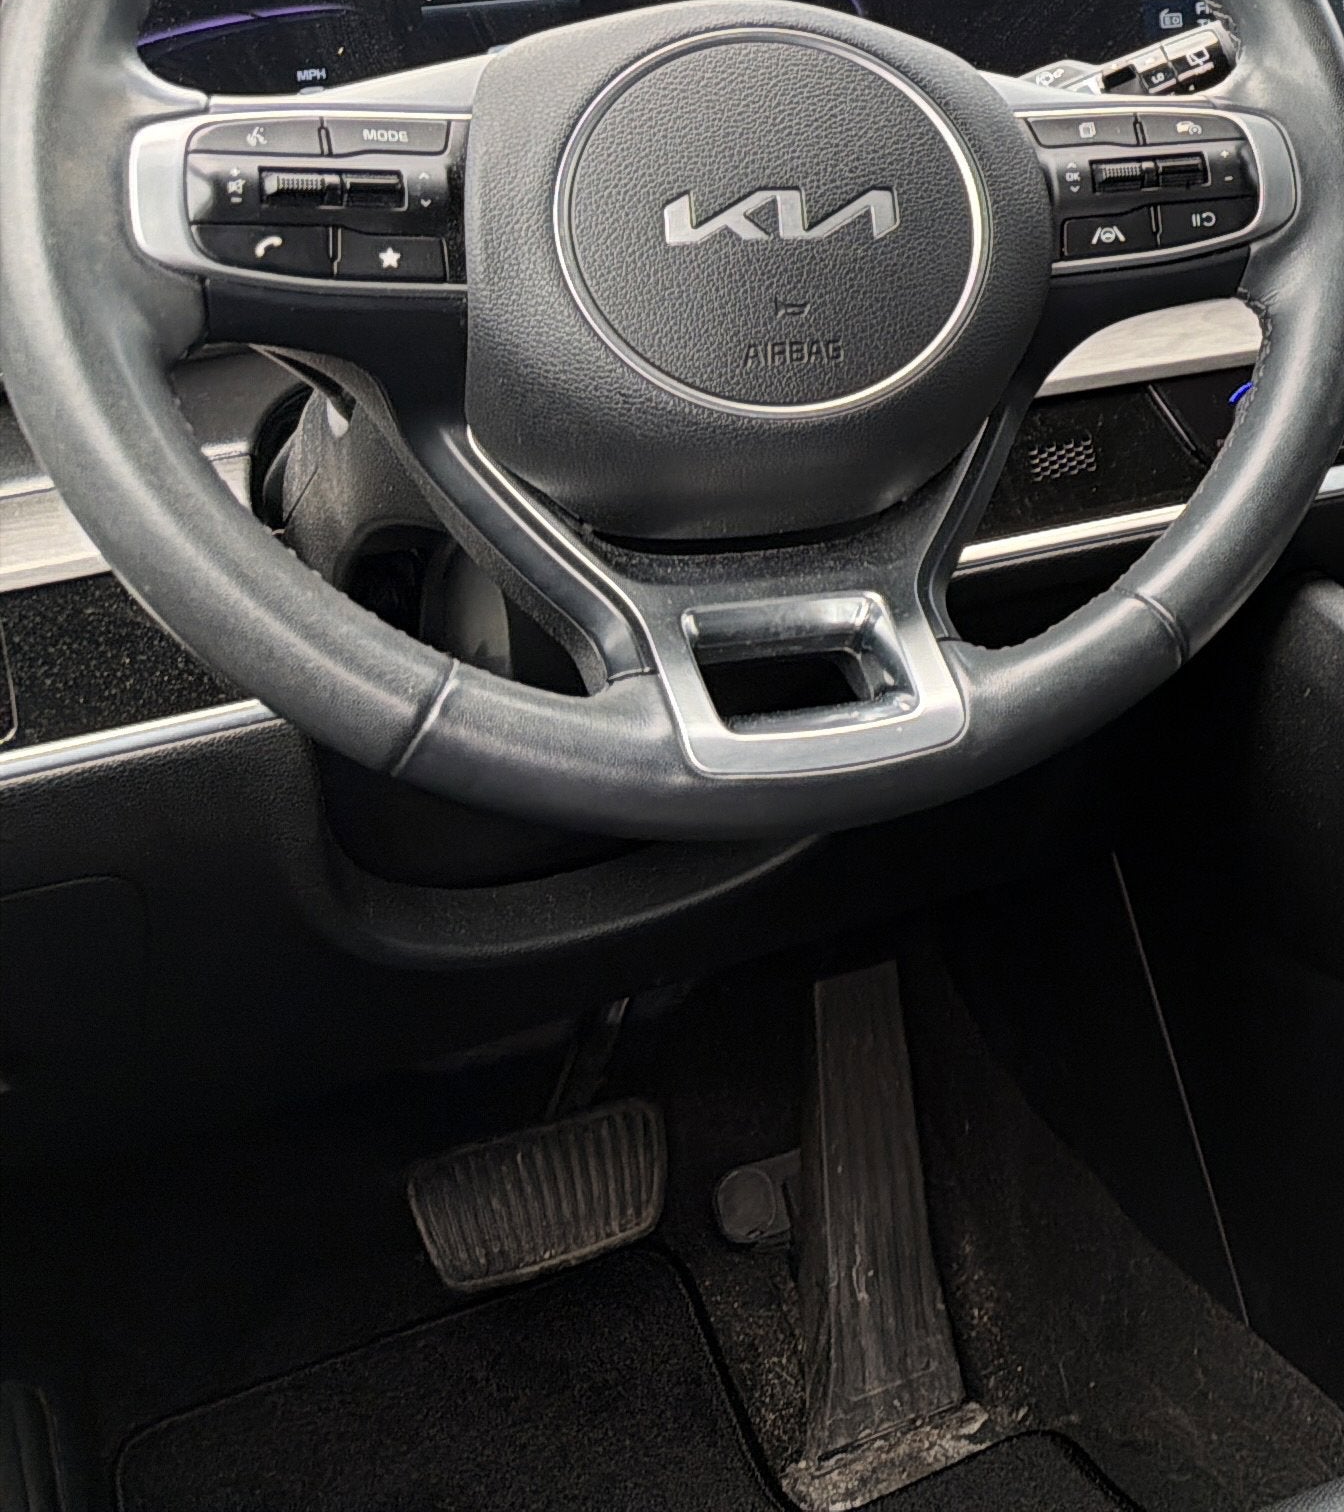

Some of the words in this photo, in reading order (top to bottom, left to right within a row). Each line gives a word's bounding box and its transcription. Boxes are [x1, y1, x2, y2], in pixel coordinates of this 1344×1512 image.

[296, 68, 327, 82] MPH
[362, 128, 409, 143] MODE
[1065, 171, 1081, 182] OK
[663, 186, 901, 246] KIA
[744, 340, 846, 369] AIRBAG
